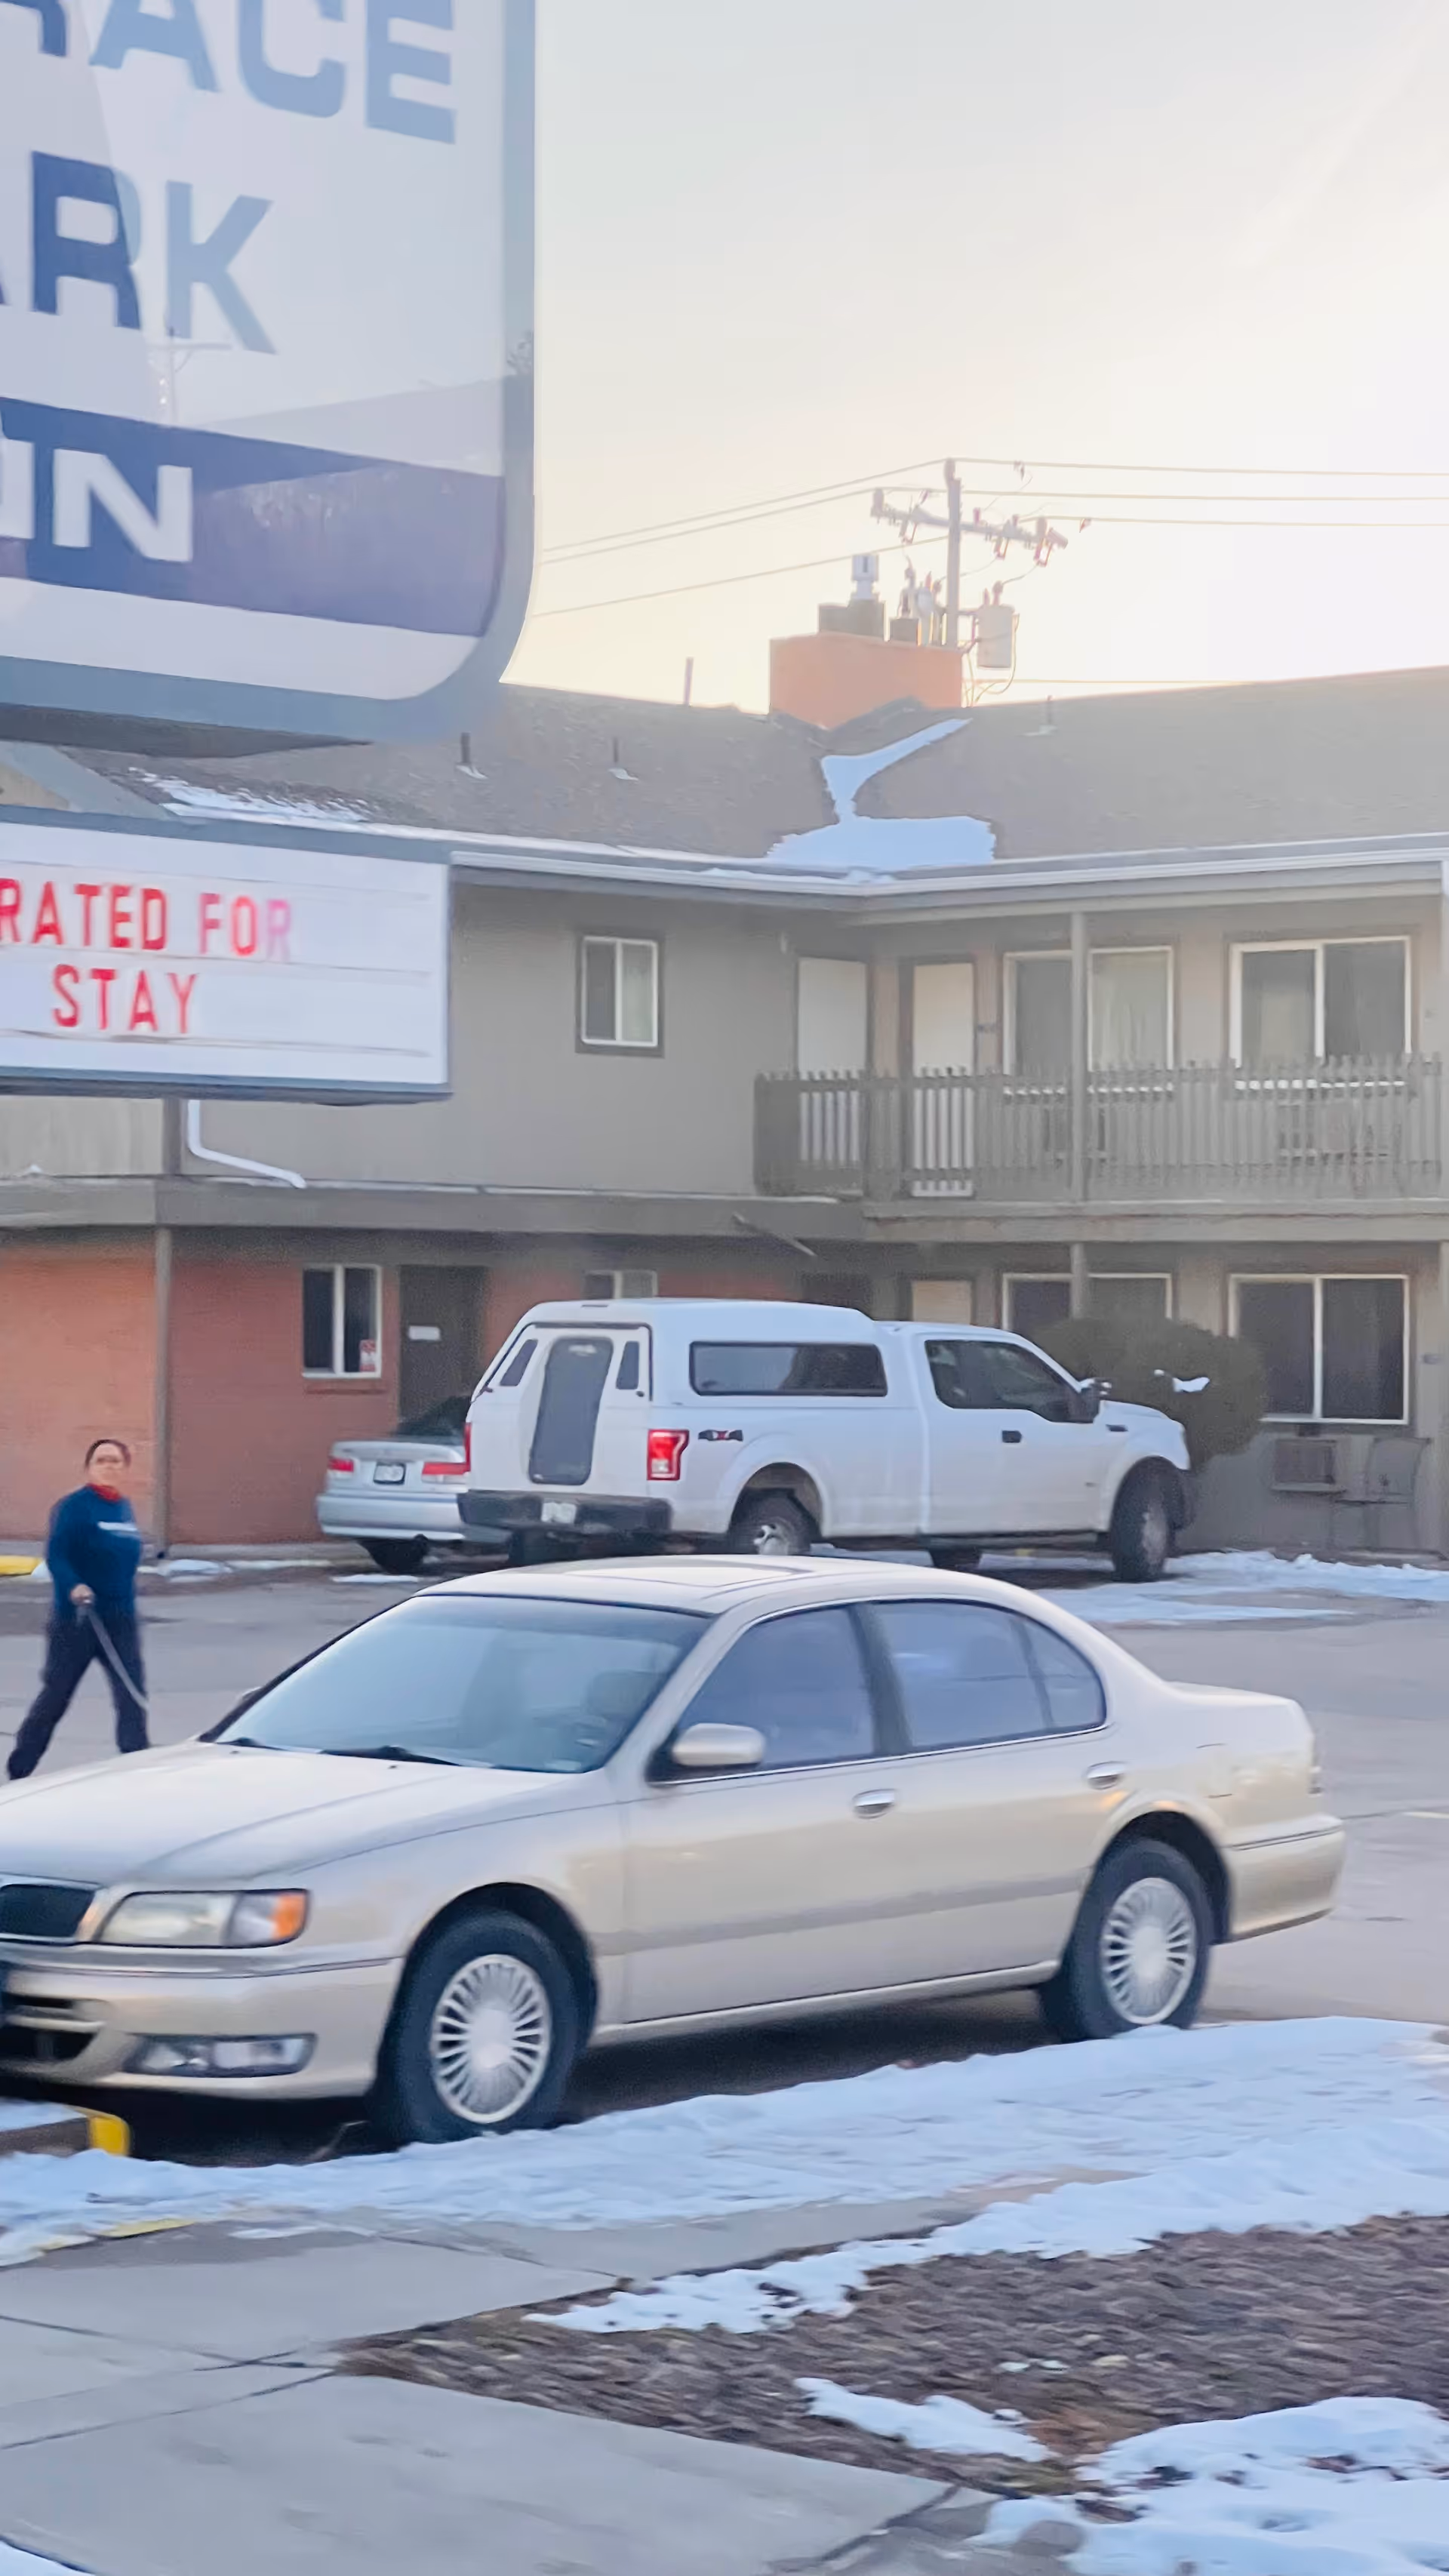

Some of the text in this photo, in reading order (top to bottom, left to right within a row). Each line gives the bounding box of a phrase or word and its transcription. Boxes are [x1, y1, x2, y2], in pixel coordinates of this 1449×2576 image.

[0, 149, 278, 355] RK
[0, 878, 291, 962] RATED FOR
[52, 964, 198, 1033] STAY
